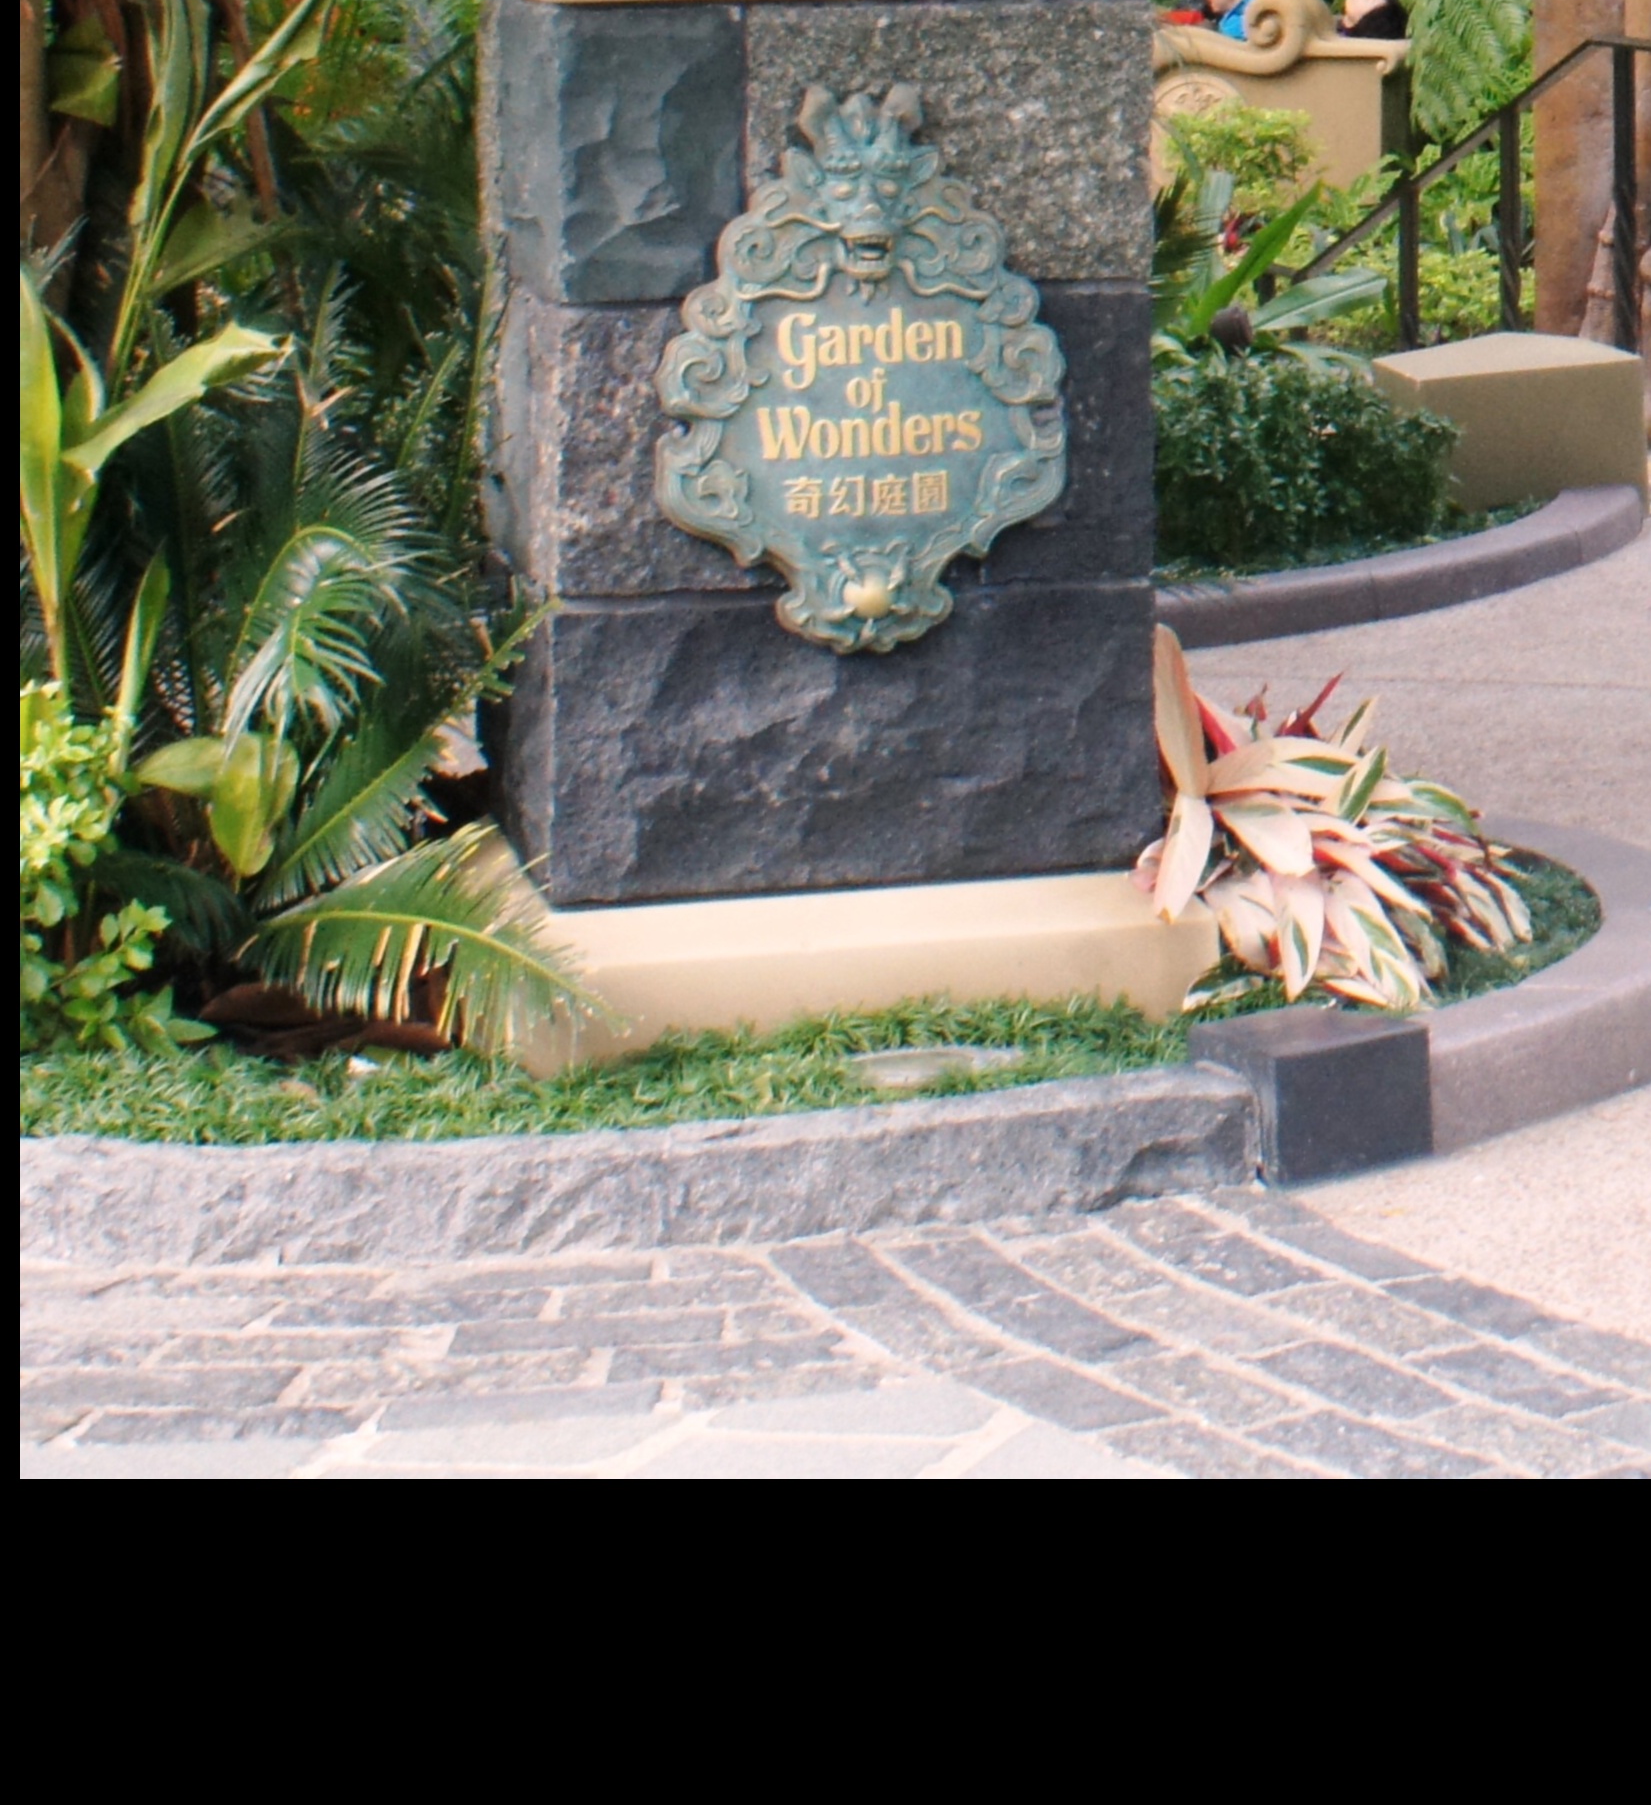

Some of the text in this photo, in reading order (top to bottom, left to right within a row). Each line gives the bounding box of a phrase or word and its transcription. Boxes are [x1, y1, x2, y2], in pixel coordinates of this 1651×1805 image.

[777, 307, 965, 390] Garden
[845, 368, 888, 412] of
[756, 402, 983, 461] Wonders
[783, 469, 949, 520] 奇幻庭園
